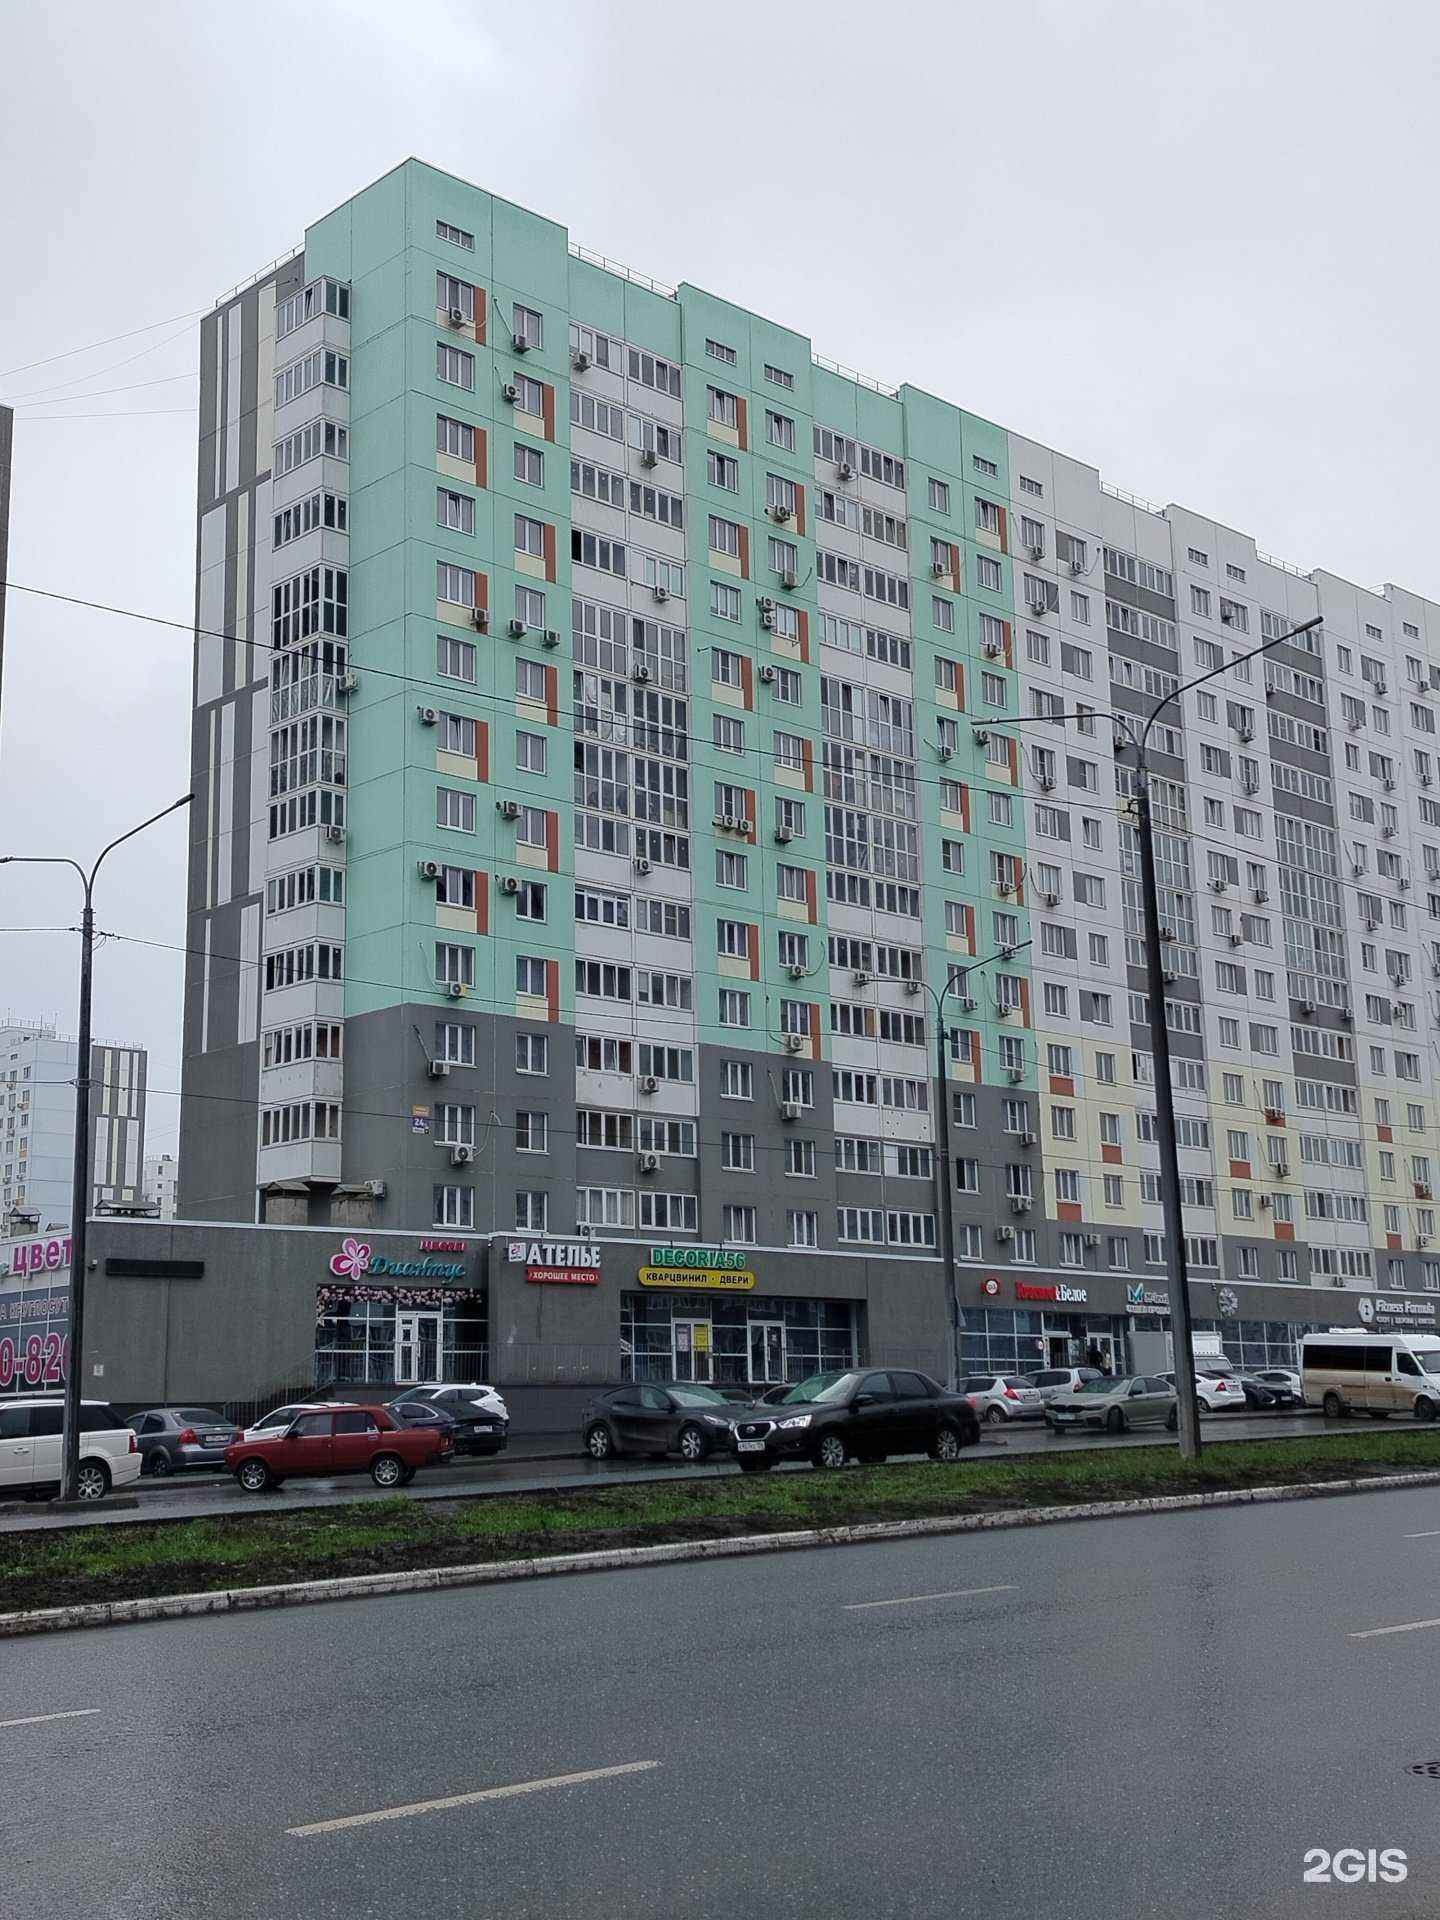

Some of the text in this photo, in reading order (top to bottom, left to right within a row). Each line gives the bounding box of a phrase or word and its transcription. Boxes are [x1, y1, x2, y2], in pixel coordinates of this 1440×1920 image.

[526, 1243, 601, 1268] АТЕЛЬЕ
[651, 1248, 746, 1270] DECORIA56
[533, 1271, 595, 1282] ХОРОШЕЕ МЕСТО
[646, 1272, 749, 1284] КВАРЦВИНИЛ ДВЕРИ
[1375, 1299, 1435, 1314] Fitness Formula
